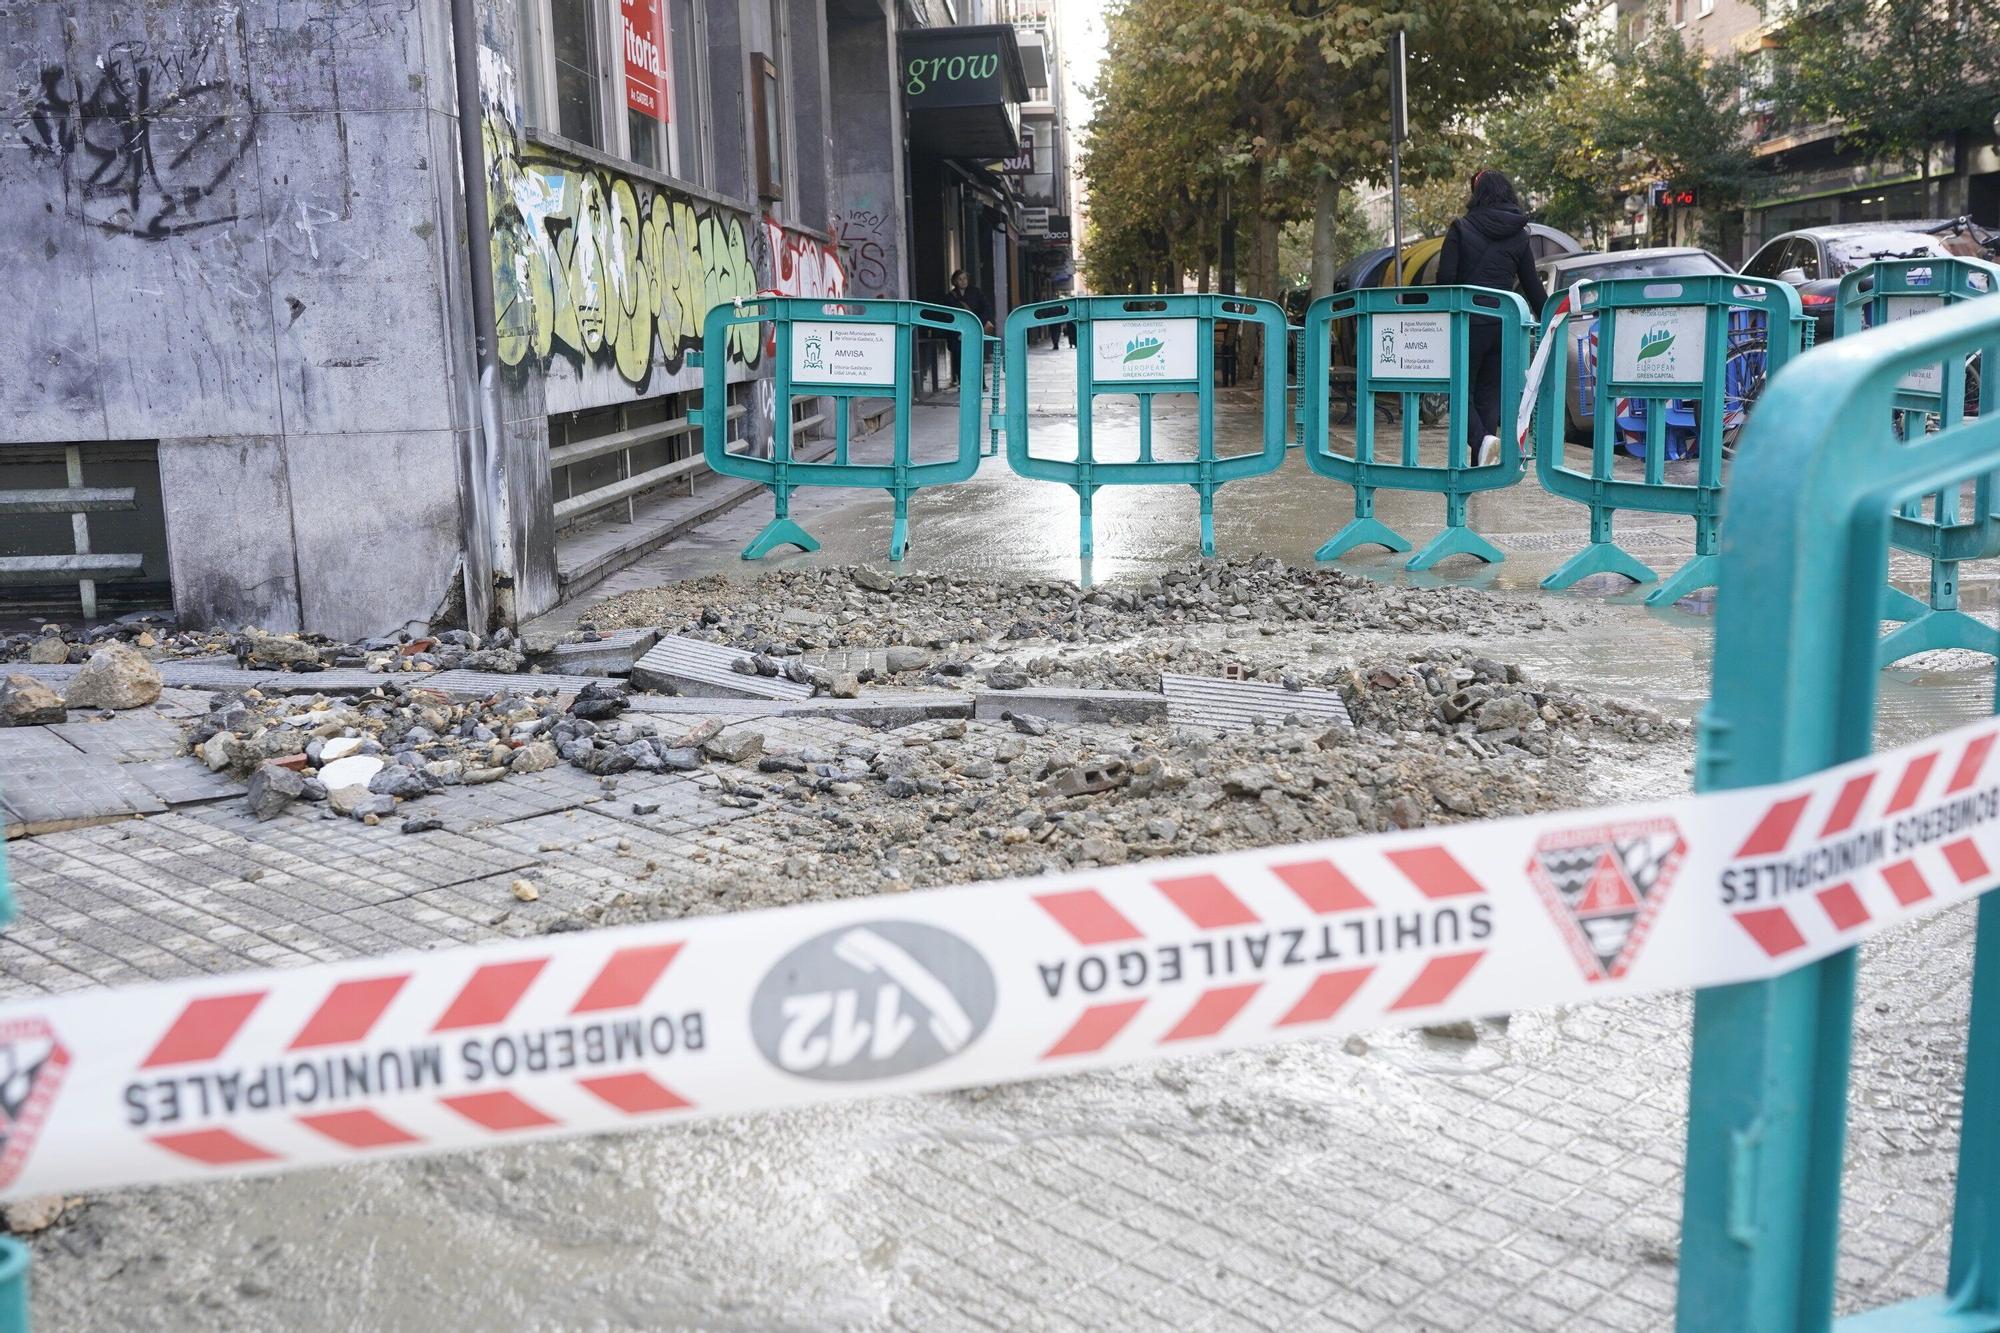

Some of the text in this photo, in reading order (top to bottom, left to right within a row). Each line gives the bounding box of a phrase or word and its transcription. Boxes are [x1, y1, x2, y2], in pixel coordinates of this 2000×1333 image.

[625, 17, 661, 78] itoria
[907, 53, 999, 95] grow
[834, 350, 864, 358] AMVISA
[1404, 341, 1428, 350] AMVISA
[1636, 364, 1675, 372] EUROPEAN
[1893, 785, 2000, 854] BOMBEROS
[1719, 825, 1885, 906] MUNICIPALES
[1038, 902, 1496, 998] SUHILTZAILEGOA
[465, 1008, 706, 1082] BOMBEROS
[776, 983, 916, 1066] 112
[124, 1041, 444, 1127] MUNICIPALES
